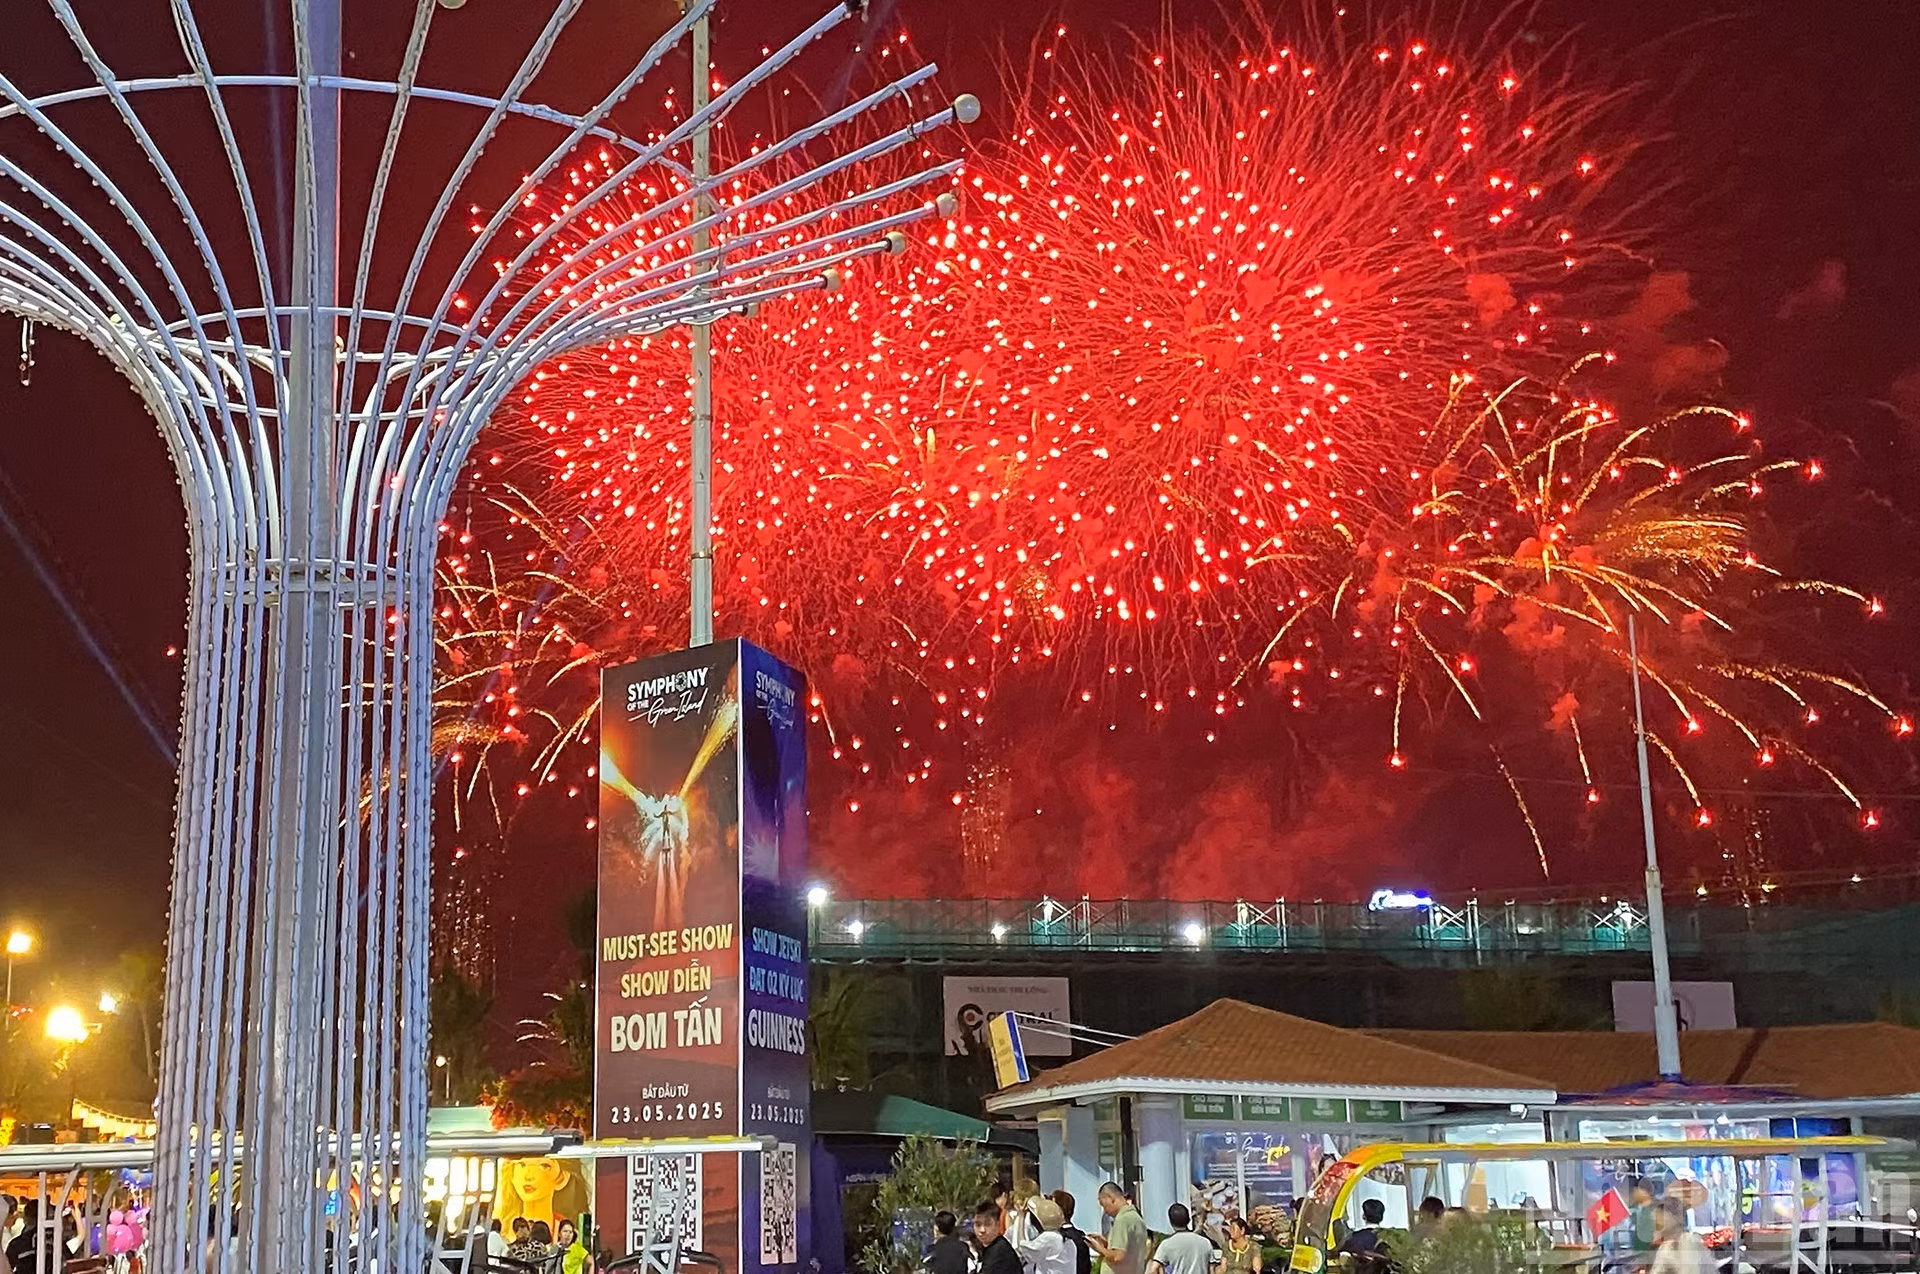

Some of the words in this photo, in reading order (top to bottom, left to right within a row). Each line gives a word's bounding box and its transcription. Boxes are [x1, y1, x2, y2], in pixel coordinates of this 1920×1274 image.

[628, 667, 708, 701] SYMPHONY
[627, 702, 637, 711] OF
[637, 700, 649, 709] THE
[603, 930, 677, 961] MUST-SEE
[681, 924, 733, 953] SHOW
[753, 926, 777, 956] SHOW
[621, 971, 669, 998] SHOW
[674, 959, 711, 993] DIỄN
[767, 970, 778, 995] 02
[611, 1012, 667, 1052] BOM
[674, 996, 722, 1047] TẤN
[748, 1008, 805, 1055] GUINNESS
[611, 1101, 723, 1124] 23.05.2025
